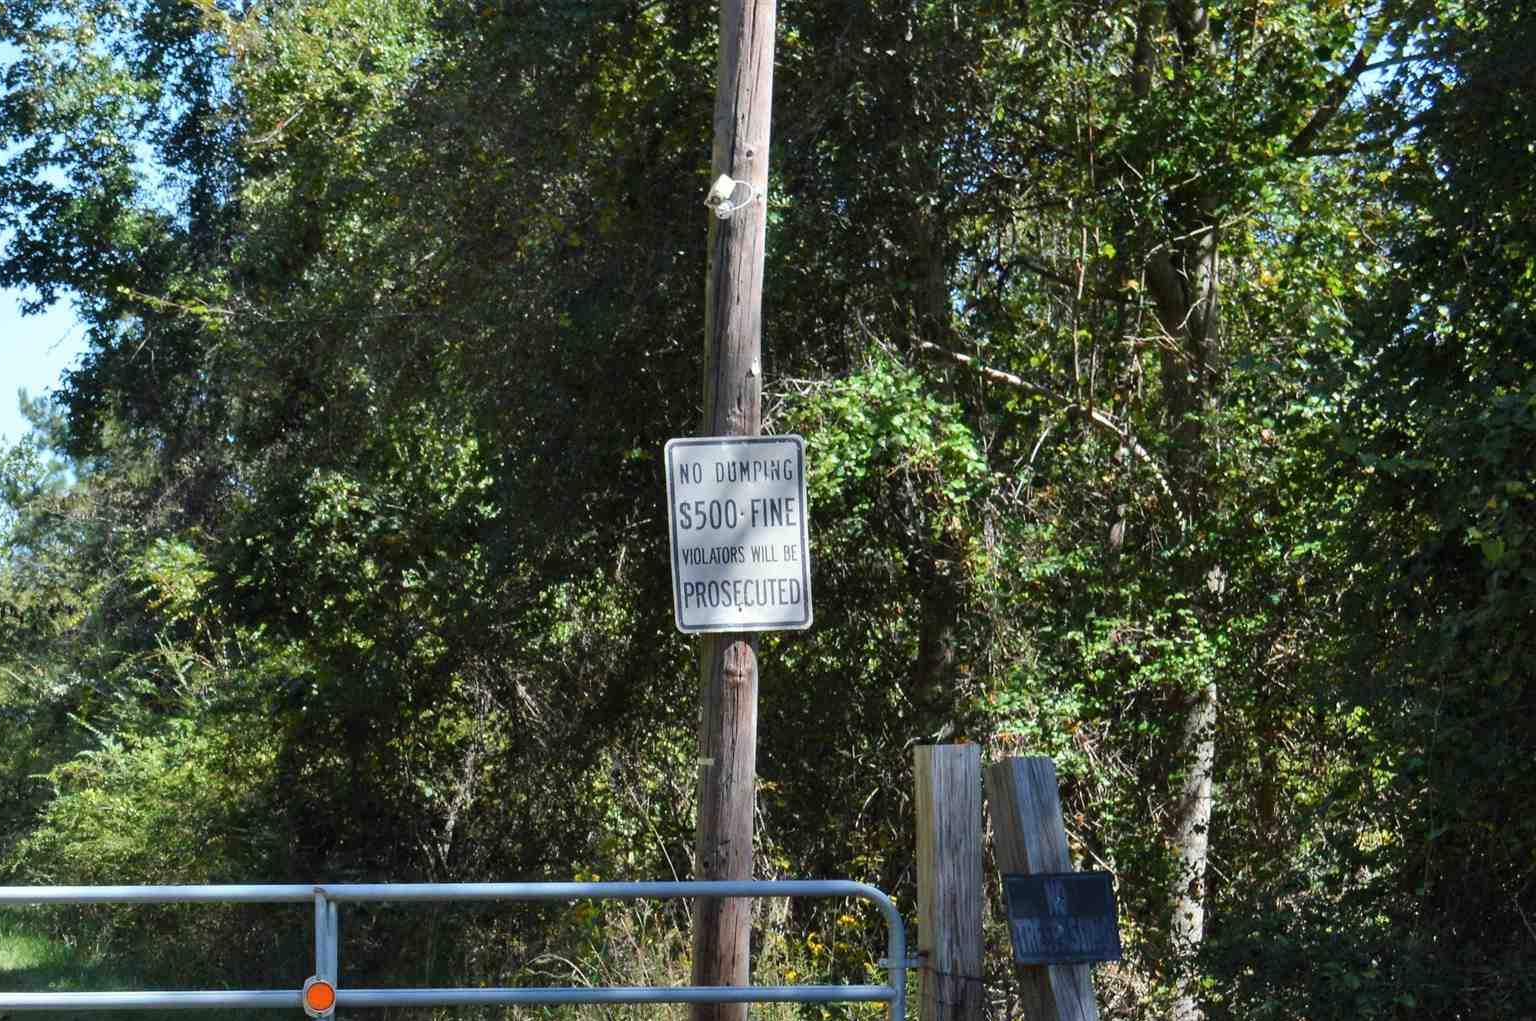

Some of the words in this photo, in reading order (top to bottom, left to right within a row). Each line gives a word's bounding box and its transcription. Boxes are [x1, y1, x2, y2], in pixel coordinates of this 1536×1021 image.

[680, 462, 702, 485] NO
[716, 459, 793, 484] DUMPING
[679, 499, 737, 530] $500
[751, 497, 797, 528] FINE
[682, 545, 745, 566] VIOLATORS
[751, 545, 778, 563] WILL
[784, 544, 798, 562] BE
[683, 578, 801, 609] PROSECUTED
